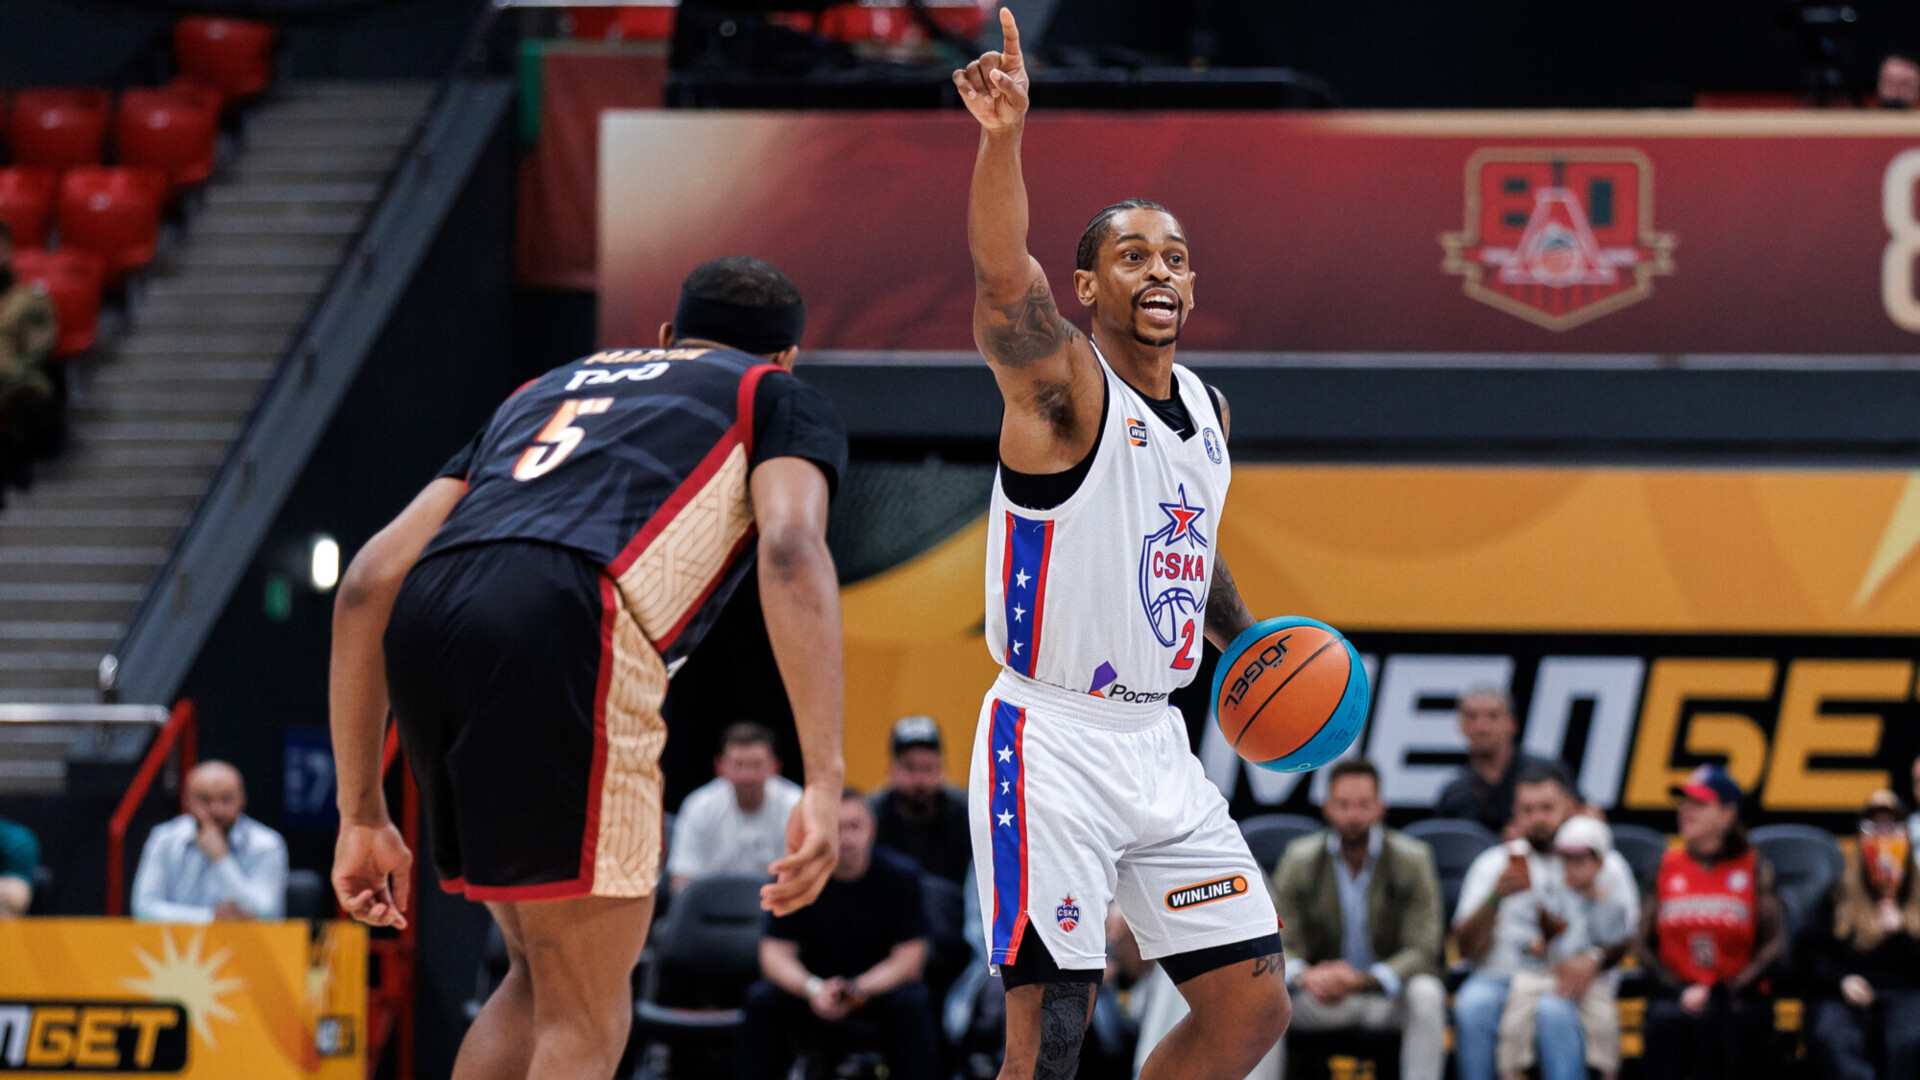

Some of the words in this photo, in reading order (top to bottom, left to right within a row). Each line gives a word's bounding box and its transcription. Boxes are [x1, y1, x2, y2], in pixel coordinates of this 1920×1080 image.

[512, 396, 615, 482] 5
[1153, 550, 1204, 582] CSKA
[1169, 618, 1195, 670] 2
[1171, 880, 1233, 907] WINLINE
[1057, 908, 1079, 918] CSKA
